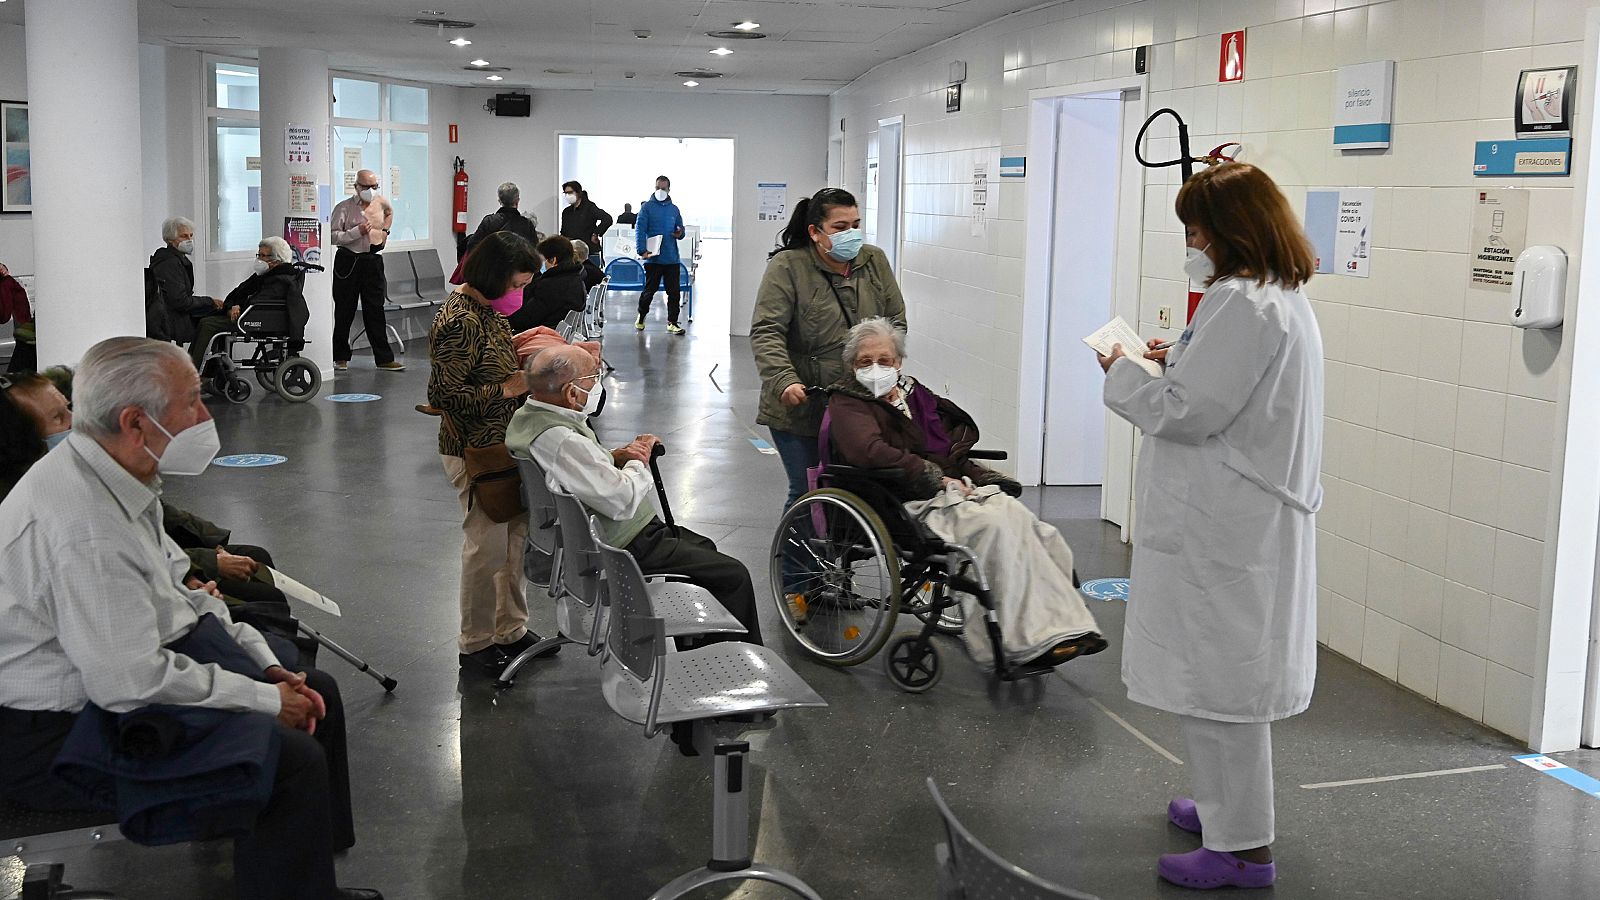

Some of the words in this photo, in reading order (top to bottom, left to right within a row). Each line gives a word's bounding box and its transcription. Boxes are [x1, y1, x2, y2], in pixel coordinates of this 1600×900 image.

[1345, 100, 1356, 110] por
[1357, 98, 1372, 107] favor
[1491, 144, 1498, 154] 9
[1518, 158, 1561, 166] EXTRACCIONES
[1483, 246, 1510, 255] ESTACIÓN
